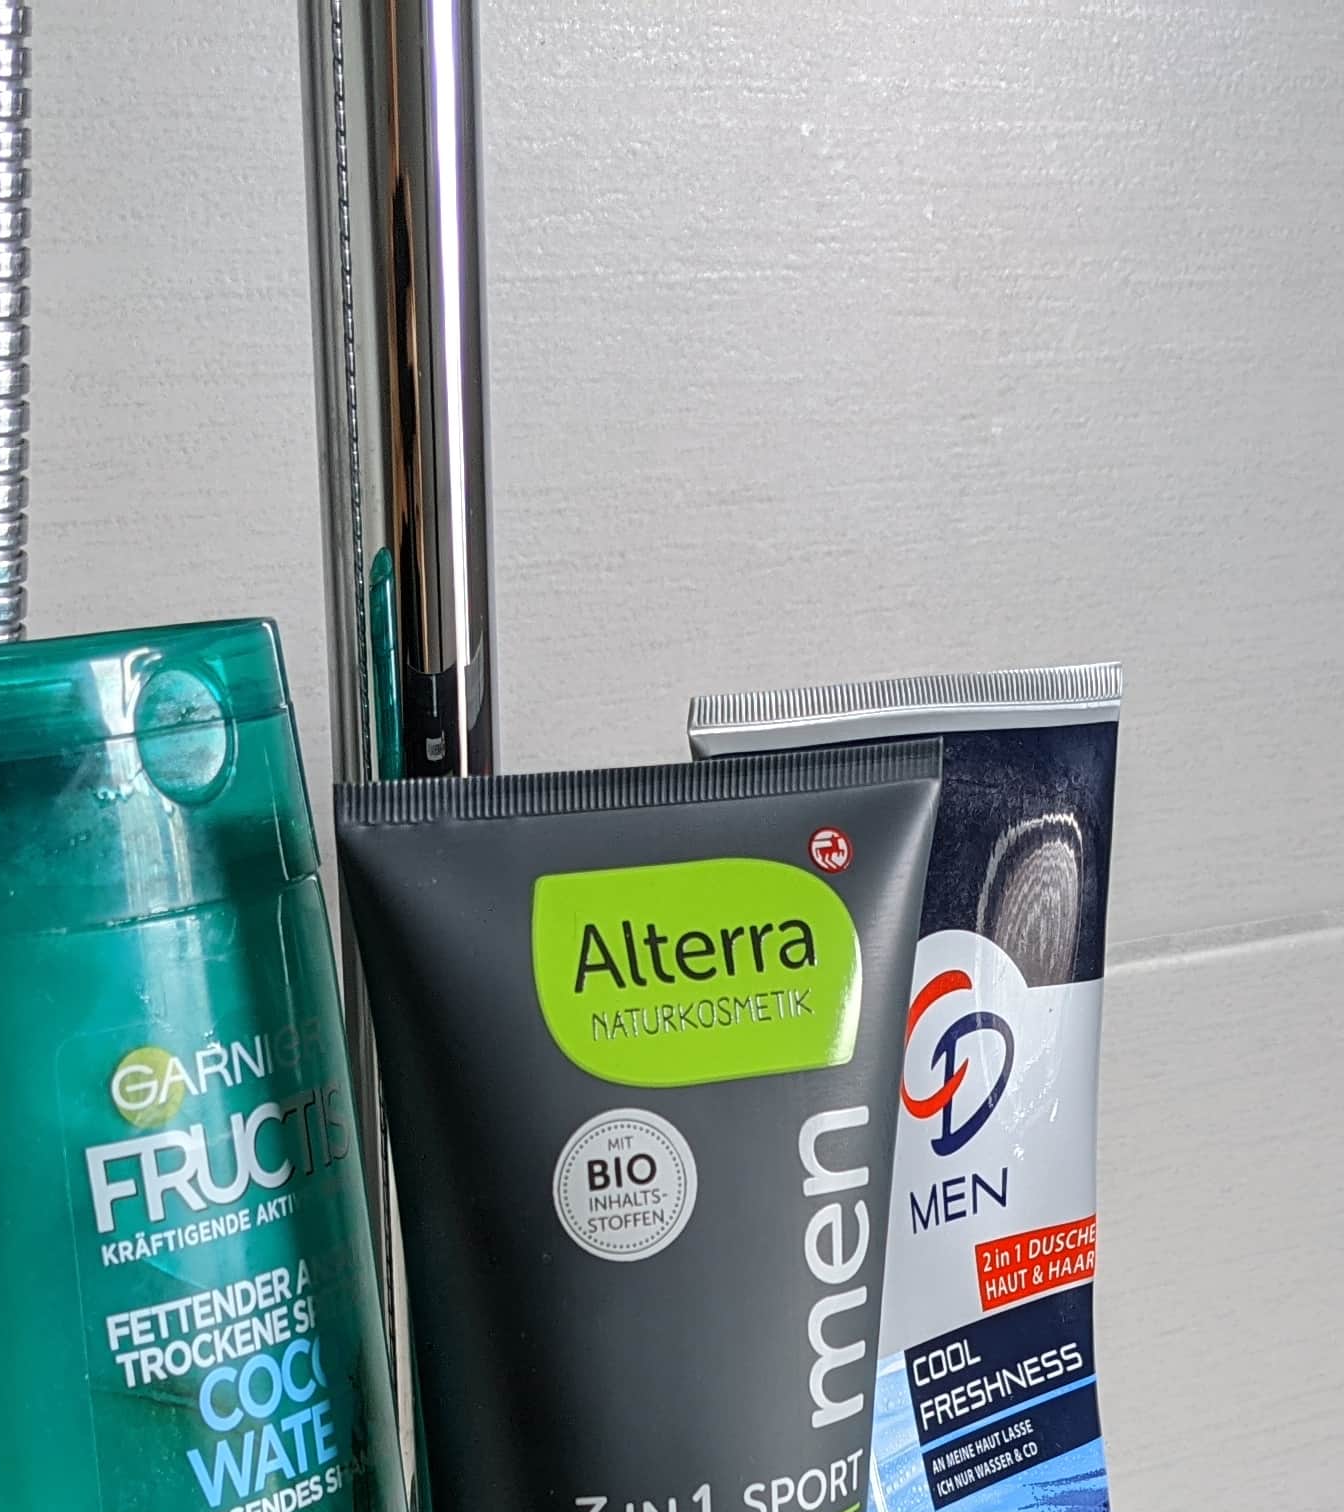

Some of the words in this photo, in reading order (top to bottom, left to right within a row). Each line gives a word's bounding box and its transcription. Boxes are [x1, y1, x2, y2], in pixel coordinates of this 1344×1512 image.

[574, 917, 817, 994] Alterra
[591, 988, 815, 1041] NATURKOSMETIK
[111, 1019, 320, 1110] GARNIE
[587, 1153, 657, 1191] BIO
[607, 1136, 634, 1151] MIT
[587, 1208, 666, 1234] STOFFEN
[589, 1188, 668, 1212] INHALTS-
[909, 1167, 1008, 1234] MEN
[101, 1209, 251, 1267] KRÄFTIGENDE
[256, 1193, 296, 1227] AKTI
[982, 1252, 993, 1272] 2
[995, 1249, 1011, 1269] in
[1014, 1243, 1022, 1265] 1
[1028, 1222, 1096, 1259] DUSCHE
[798, 1105, 870, 1429] men
[985, 1270, 1028, 1301] HAUT
[1032, 1267, 1044, 1285] &
[1048, 1250, 1095, 1281] HAAR
[106, 1267, 292, 1351] FETTENDER
[115, 1306, 291, 1388] TROCKENE
[912, 1339, 982, 1387] COOL
[919, 1342, 1084, 1431] FRESHNESS
[186, 1400, 338, 1508] WATE
[932, 1457, 946, 1475] AN
[945, 1442, 977, 1470] MEINE
[975, 1431, 1001, 1454] HAUT
[1002, 1419, 1035, 1443] LASSE
[936, 1474, 954, 1498] ICH
[954, 1467, 975, 1490] NUR
[974, 1450, 1014, 1481] WASSER
[1013, 1446, 1023, 1463] &
[1022, 1441, 1039, 1458] CD
